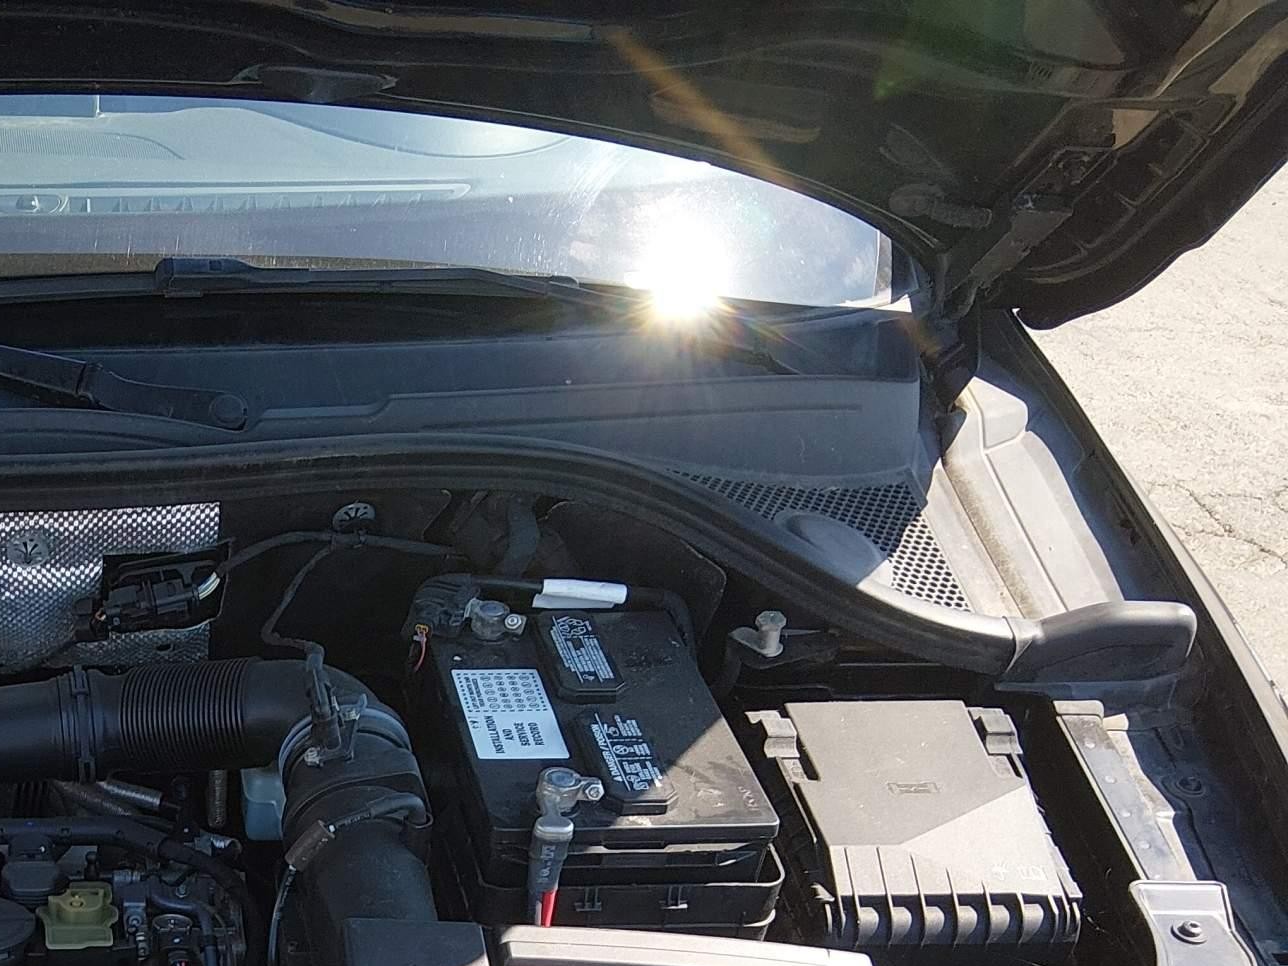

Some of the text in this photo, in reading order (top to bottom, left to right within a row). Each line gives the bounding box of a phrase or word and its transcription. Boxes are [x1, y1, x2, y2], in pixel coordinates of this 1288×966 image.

[484, 715, 506, 754] INSTALLATION
[502, 728, 515, 741] AND
[514, 722, 531, 746] SERVICE
[528, 722, 545, 746] RECORD
[591, 724, 607, 746] POISON
[602, 751, 620, 776] DANGER
